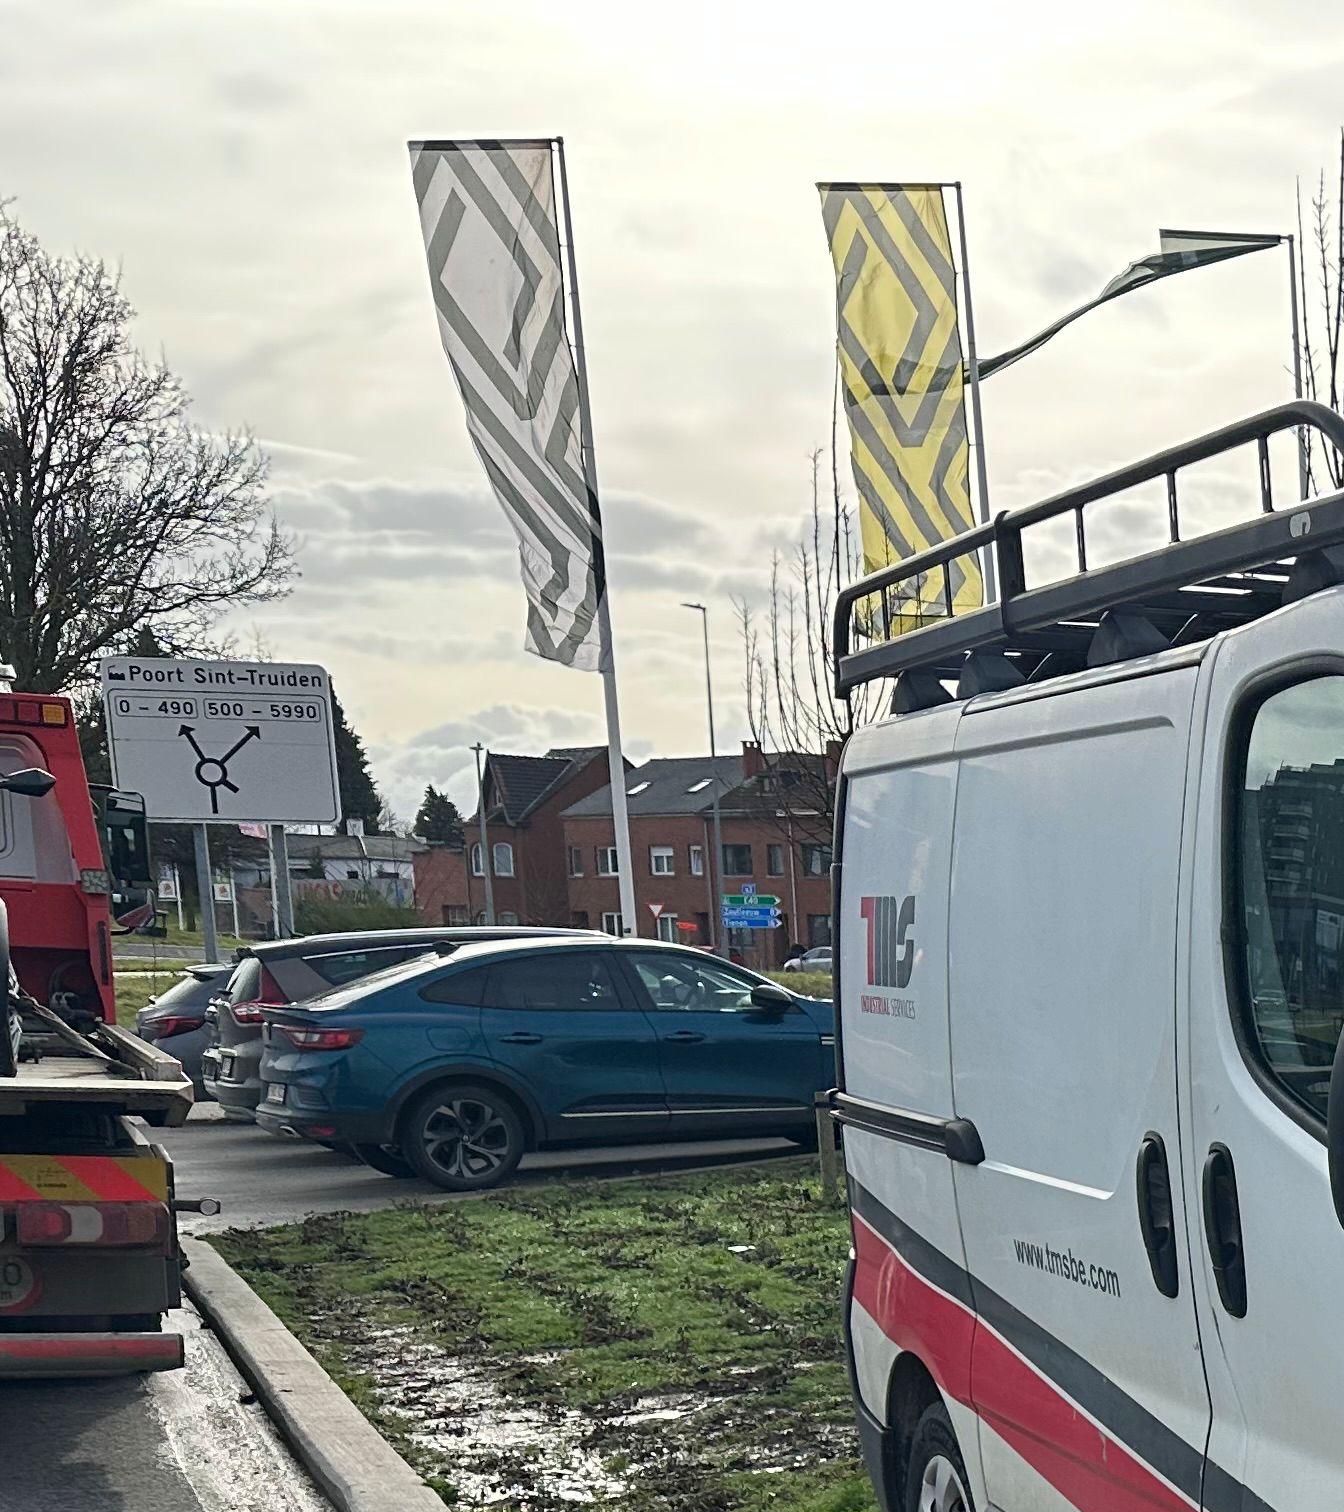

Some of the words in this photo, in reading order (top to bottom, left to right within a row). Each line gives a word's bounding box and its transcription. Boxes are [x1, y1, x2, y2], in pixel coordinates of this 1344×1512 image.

[128, 665, 184, 683] Poort
[194, 667, 322, 687] Sint-Truiden
[119, 700, 130, 713] 0
[158, 701, 194, 715] 490
[208, 702, 243, 717] 500
[270, 704, 317, 719] 5990
[860, 895, 915, 988] TMS
[861, 995, 890, 1015] INDUSTRIAL
[891, 998, 916, 1019] SERVICES
[1013, 1239, 1121, 1298] www.tmsbe.com
